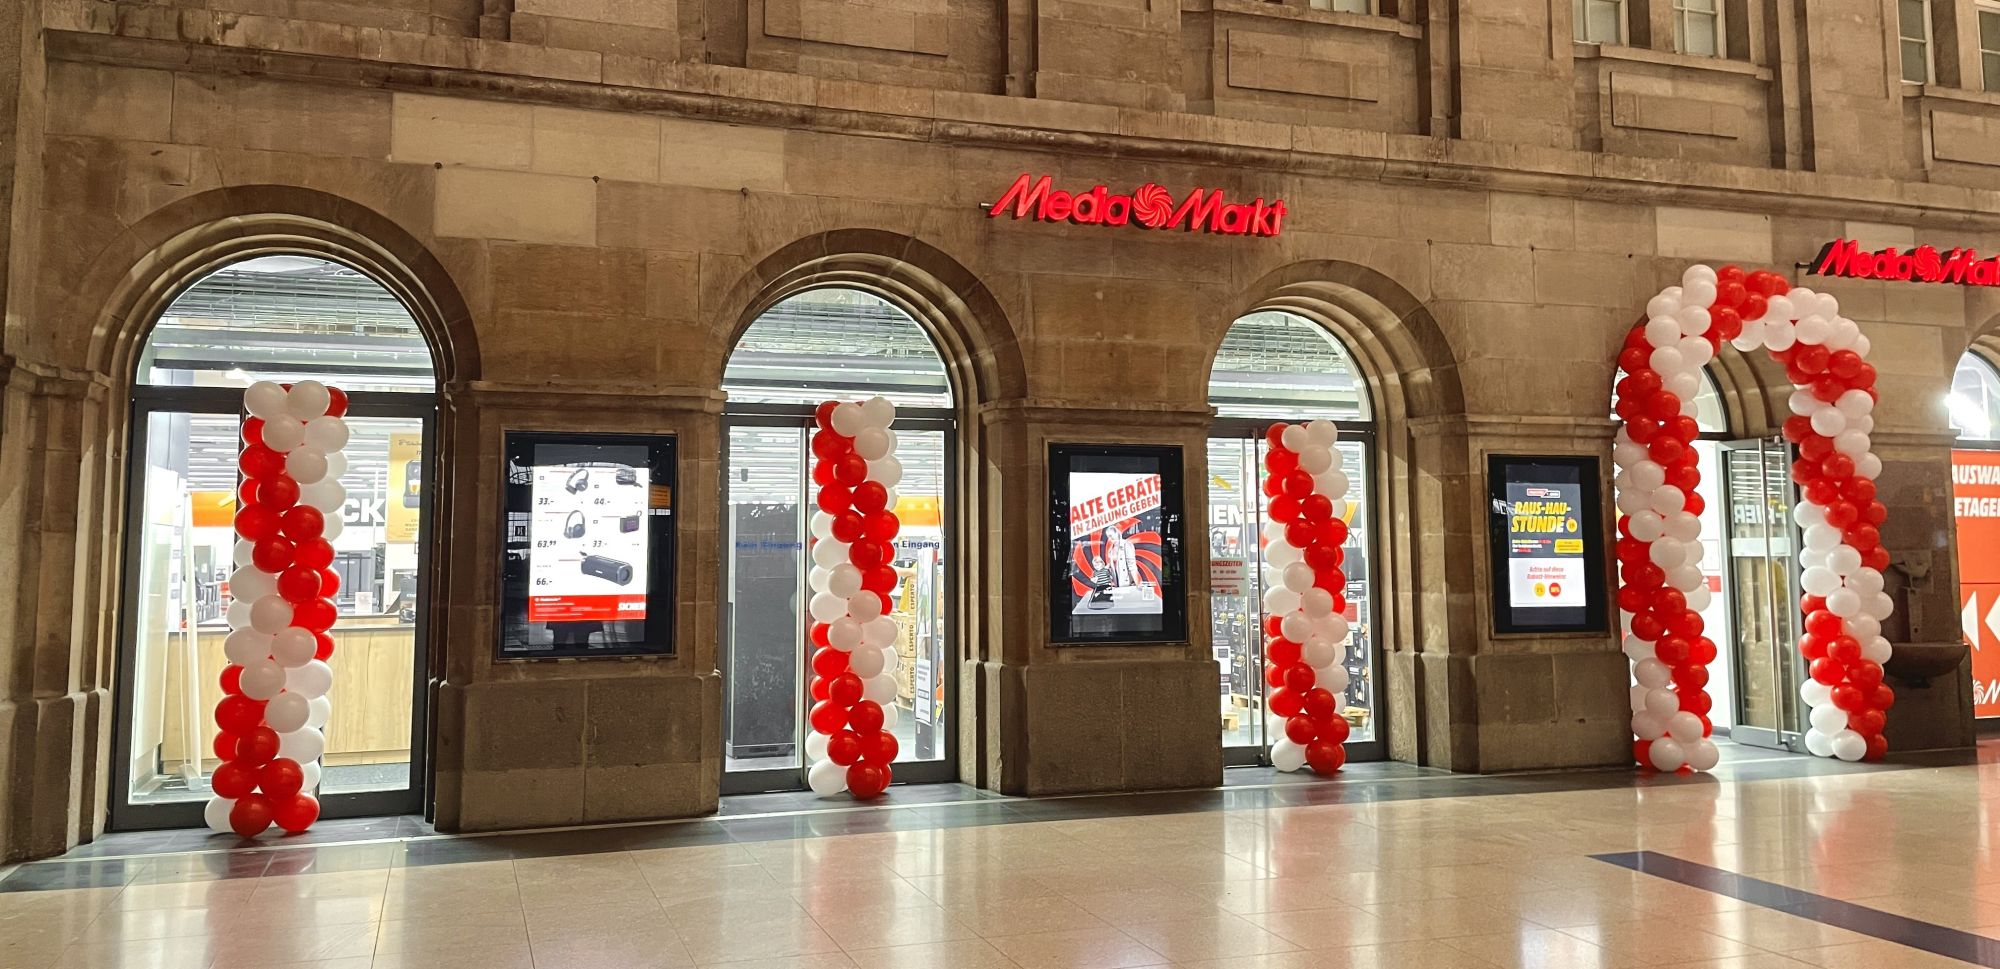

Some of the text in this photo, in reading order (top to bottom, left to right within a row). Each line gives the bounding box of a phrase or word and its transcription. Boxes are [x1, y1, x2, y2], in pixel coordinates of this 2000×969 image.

[989, 173, 1287, 236] Media Markt
[1817, 238, 1912, 281] Media
[1071, 475, 1161, 524] ALTE GERÄTE
[1072, 494, 1160, 536] IN ZAHLUNG GEBEN
[1954, 496, 2000, 517] ETAGE
[902, 540, 940, 549] Eingang
[1511, 515, 1565, 533] STUNDE
